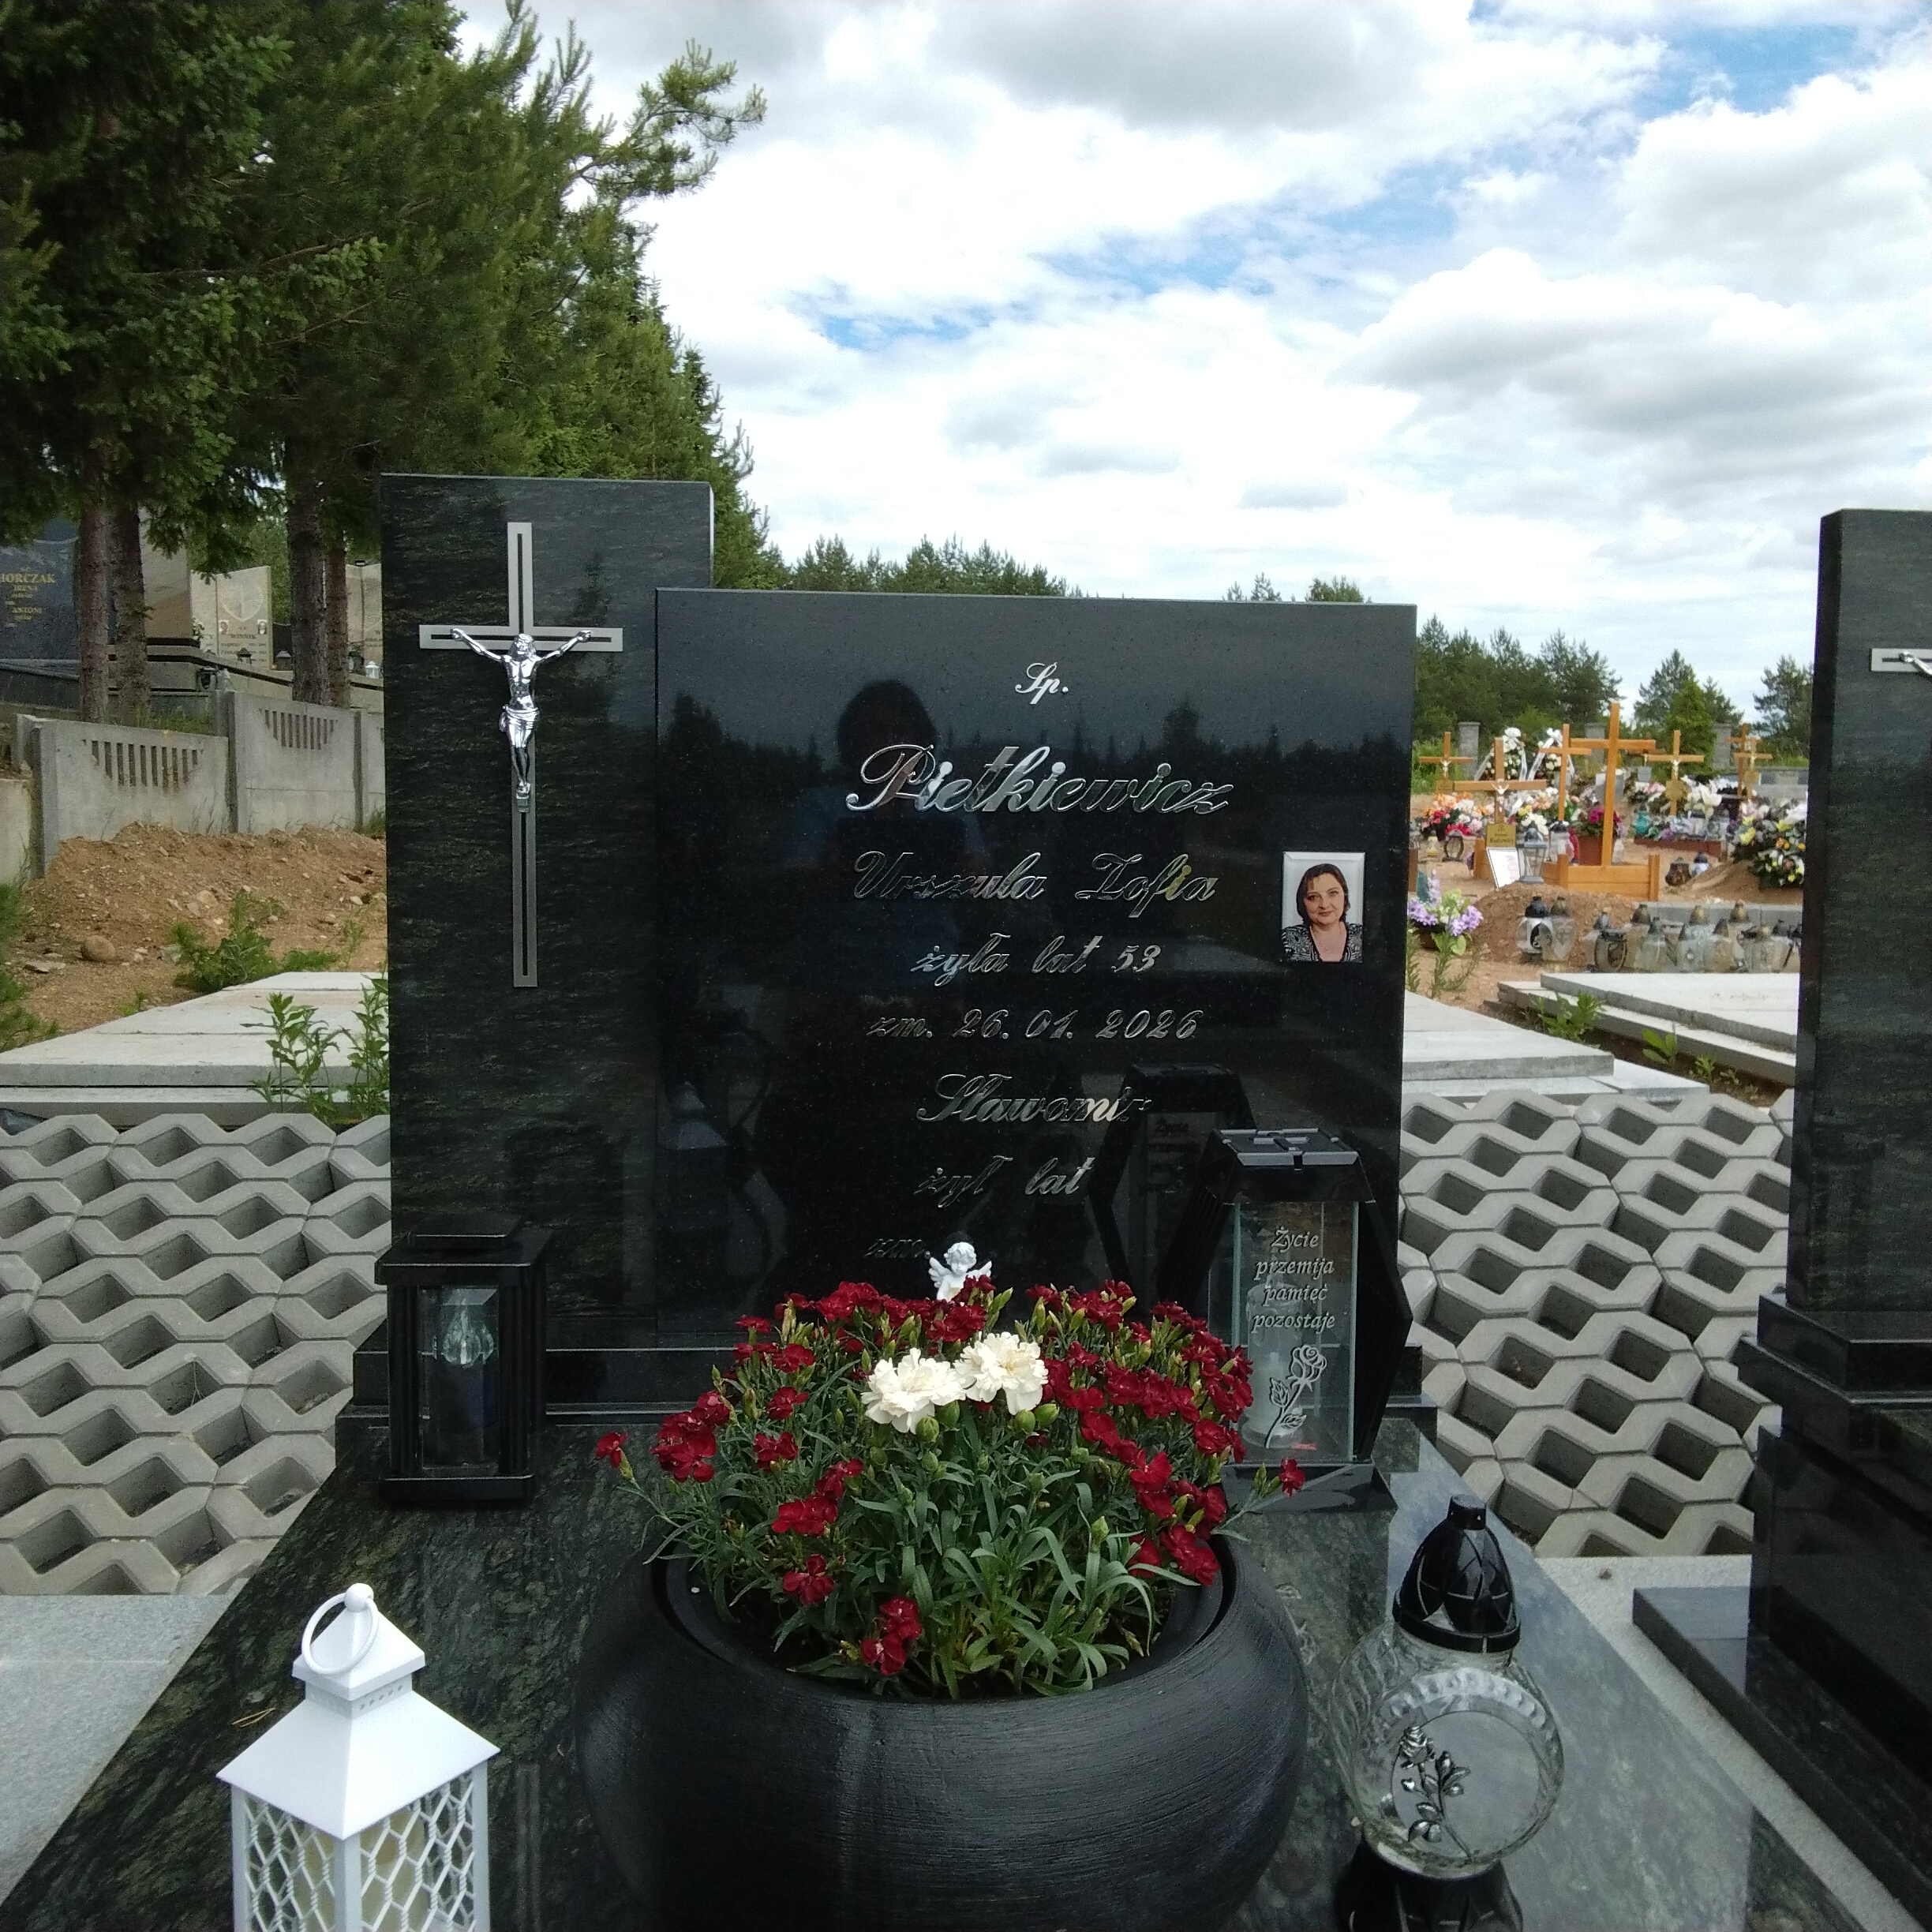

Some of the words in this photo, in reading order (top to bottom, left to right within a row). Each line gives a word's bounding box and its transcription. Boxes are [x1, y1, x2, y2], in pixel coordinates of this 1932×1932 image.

[845, 744, 1234, 814] Pietkiewicz
[853, 851, 1047, 900] Urszula
[1074, 852, 1220, 918] Zofia
[910, 932, 1012, 987] żyła
[1032, 935, 1103, 974] lat
[1111, 945, 1162, 973] 53
[867, 1017, 934, 1039] zm.
[951, 1008, 1010, 1039] 26.
[1095, 1009, 1204, 1039] 2026
[1025, 1157, 1095, 1195] lat
[1271, 1226, 1319, 1253] Życie
[1253, 1257, 1335, 1281] przemija
[1262, 1283, 1328, 1307] pamięć
[1250, 1311, 1335, 1334] pozostaje
